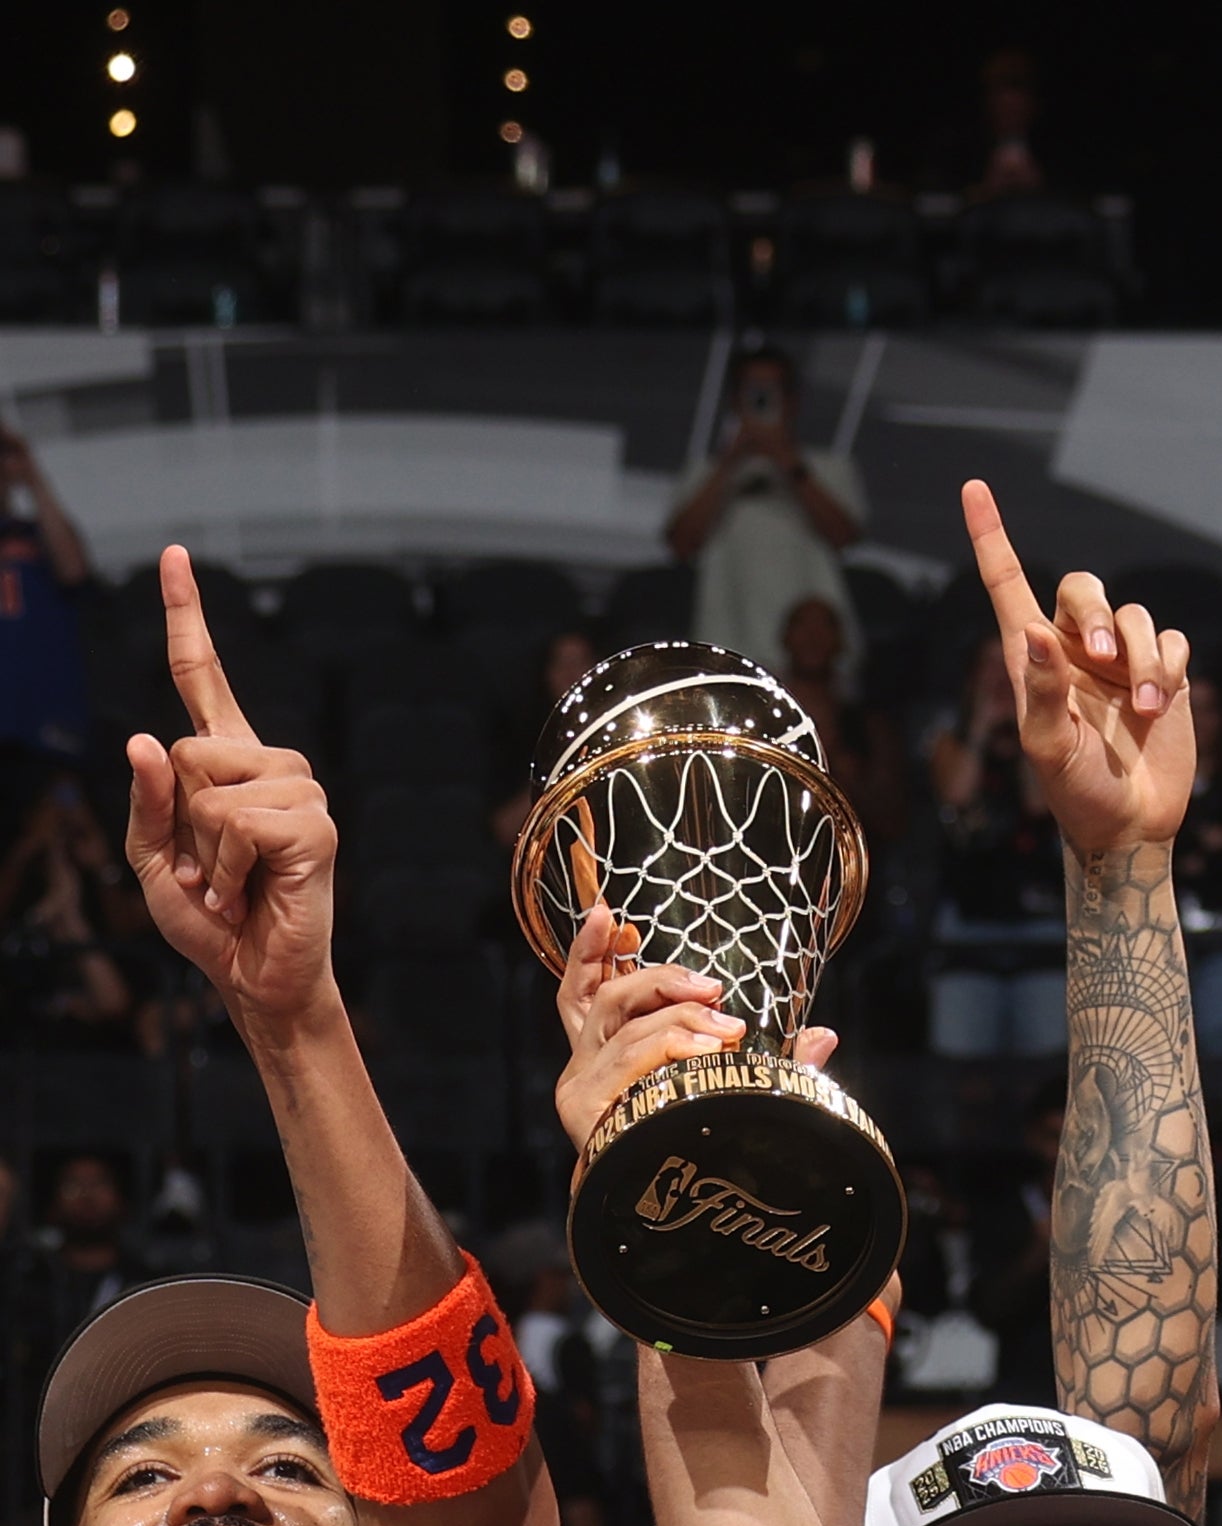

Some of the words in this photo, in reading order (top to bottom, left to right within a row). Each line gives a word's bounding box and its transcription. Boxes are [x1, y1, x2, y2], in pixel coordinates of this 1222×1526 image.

[588, 1107, 627, 1163] 2026
[631, 1079, 678, 1121] NBA
[684, 1065, 772, 1095] FINALS
[779, 1069, 845, 1118] MOST
[642, 1177, 831, 1272] Finals
[375, 1314, 520, 1475] 32
[942, 1431, 974, 1456] NBA
[975, 1418, 1065, 1441] CHAMPIONS
